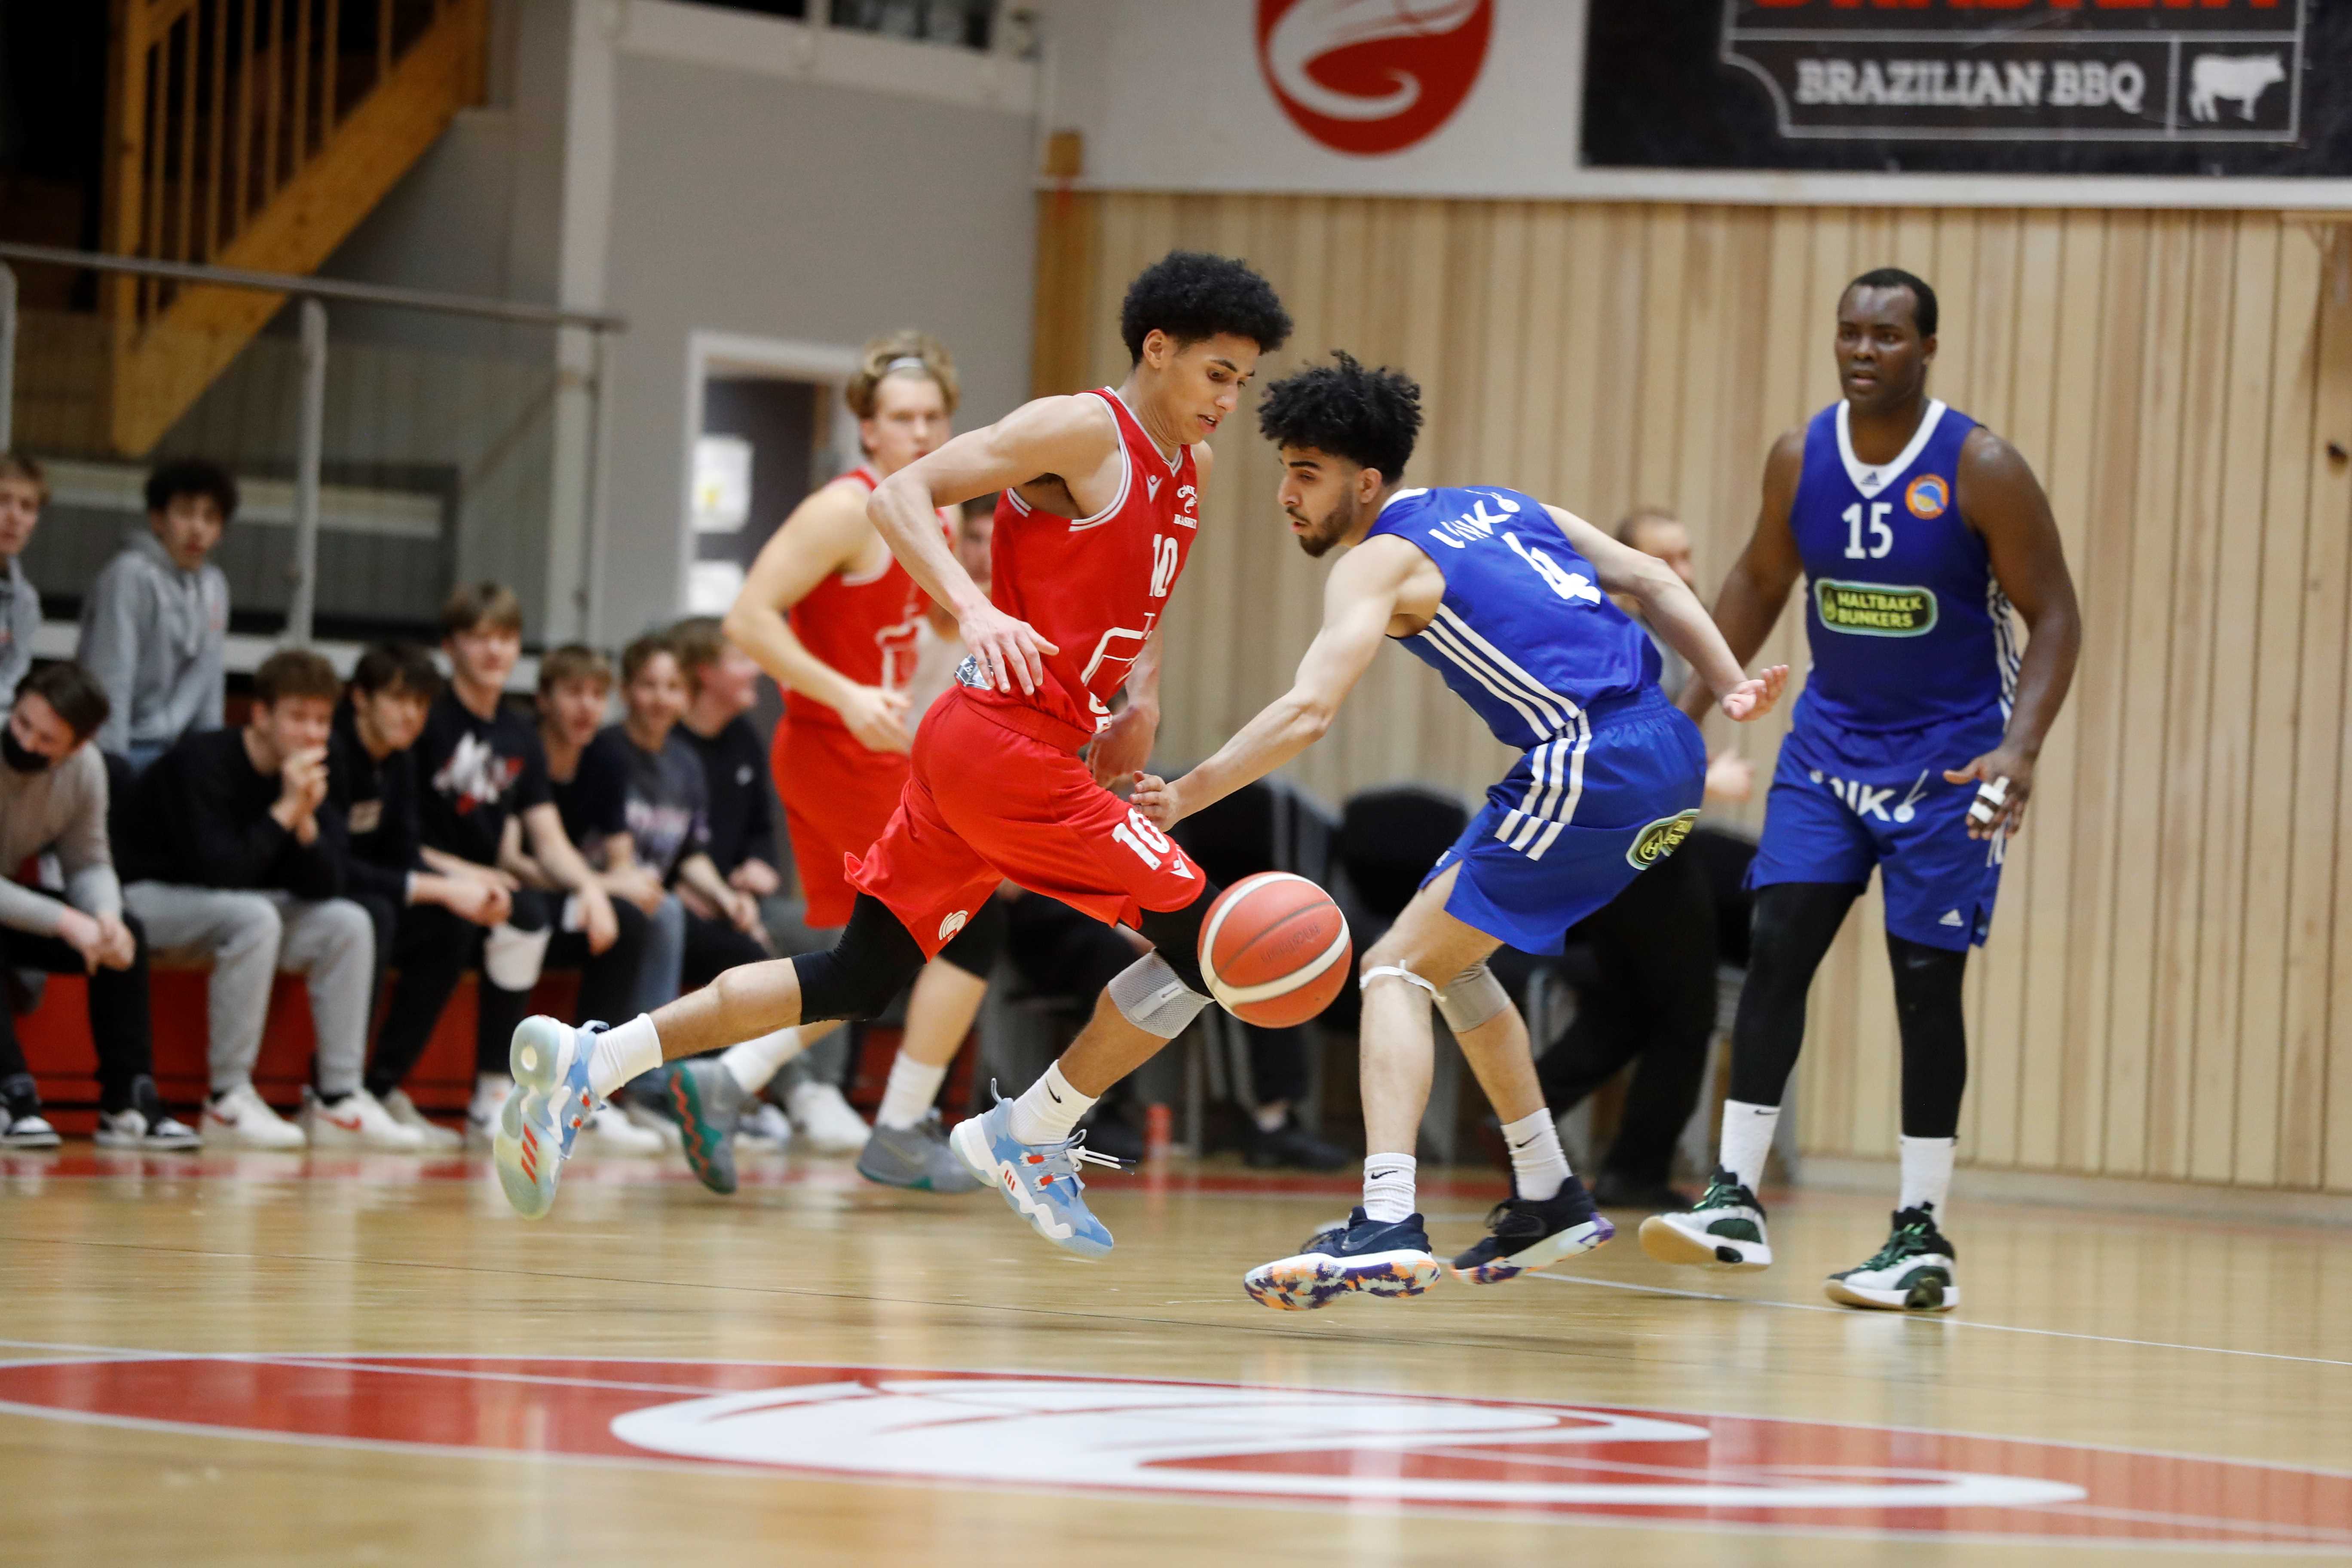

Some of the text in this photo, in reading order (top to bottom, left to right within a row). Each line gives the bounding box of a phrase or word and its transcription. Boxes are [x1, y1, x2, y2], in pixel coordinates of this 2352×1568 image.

[1797, 59, 2146, 113] BRAZILIAN BBQ
[1841, 502, 1893, 559] 15
[1148, 533, 1179, 597] 10
[1837, 591, 1923, 612] HALTBAKK
[1837, 607, 1914, 628] BUNKERS
[1111, 808, 1170, 871] 10
